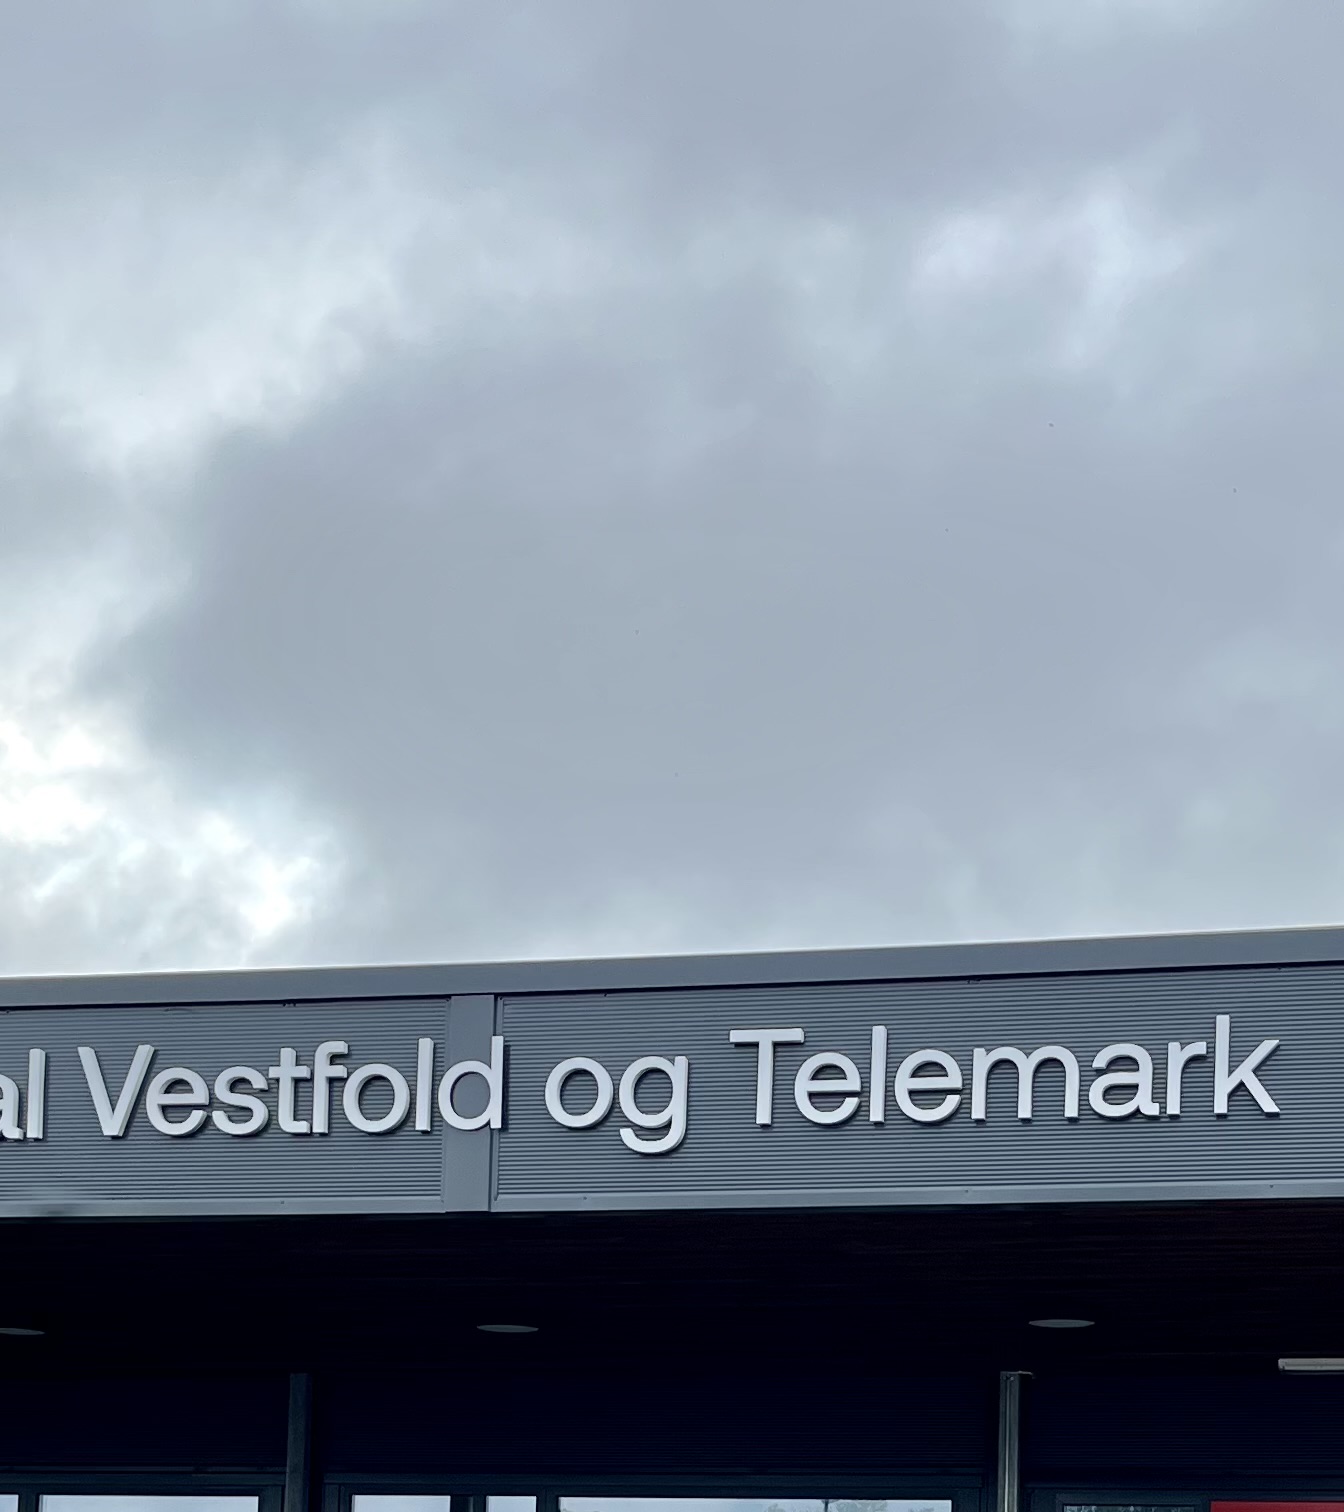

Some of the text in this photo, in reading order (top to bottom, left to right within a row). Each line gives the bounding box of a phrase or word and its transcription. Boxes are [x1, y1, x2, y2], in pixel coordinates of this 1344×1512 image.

[77, 1035, 506, 1137] Vestfold
[544, 1055, 690, 1154] og
[728, 1015, 1280, 1127] Telemark
